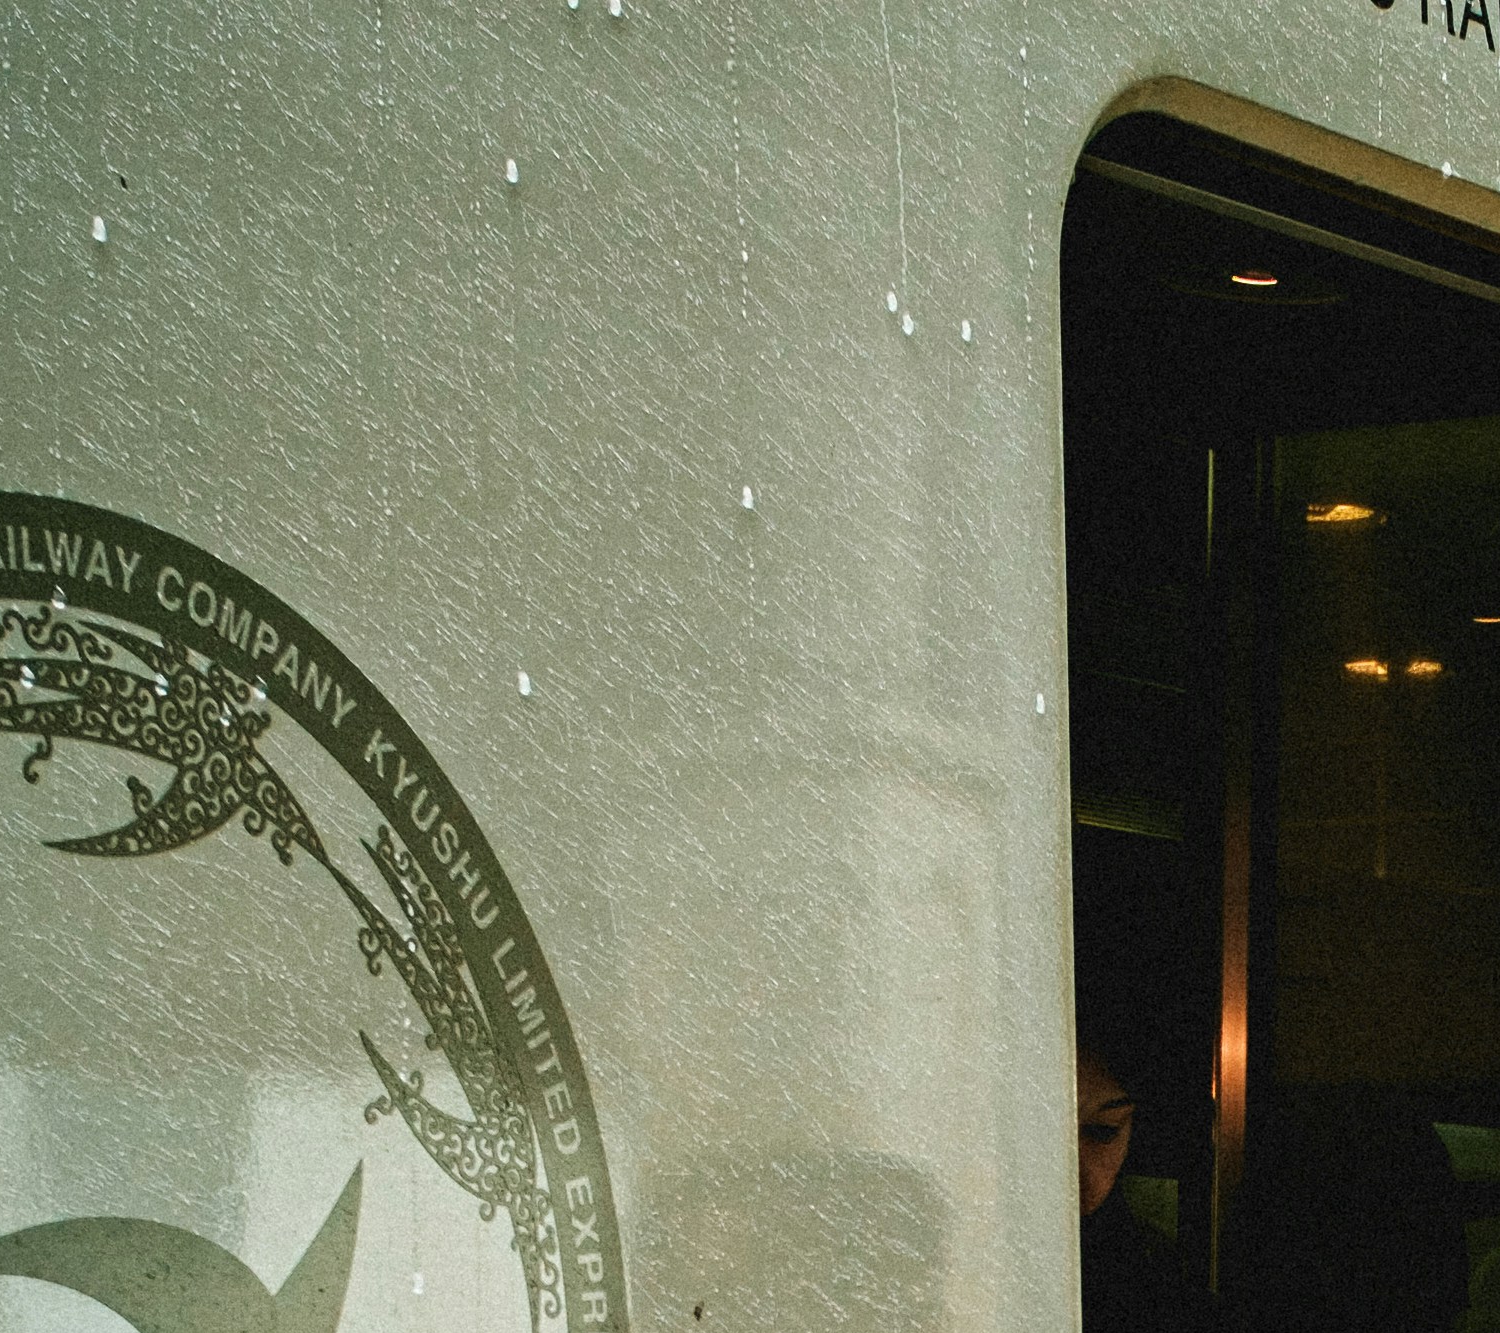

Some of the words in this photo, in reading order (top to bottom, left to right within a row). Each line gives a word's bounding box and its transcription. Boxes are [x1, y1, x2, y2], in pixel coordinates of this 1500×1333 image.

[153, 564, 356, 734] COMPANY
[361, 728, 502, 935] KYUSHU
[489, 936, 584, 1158] LIMITED
